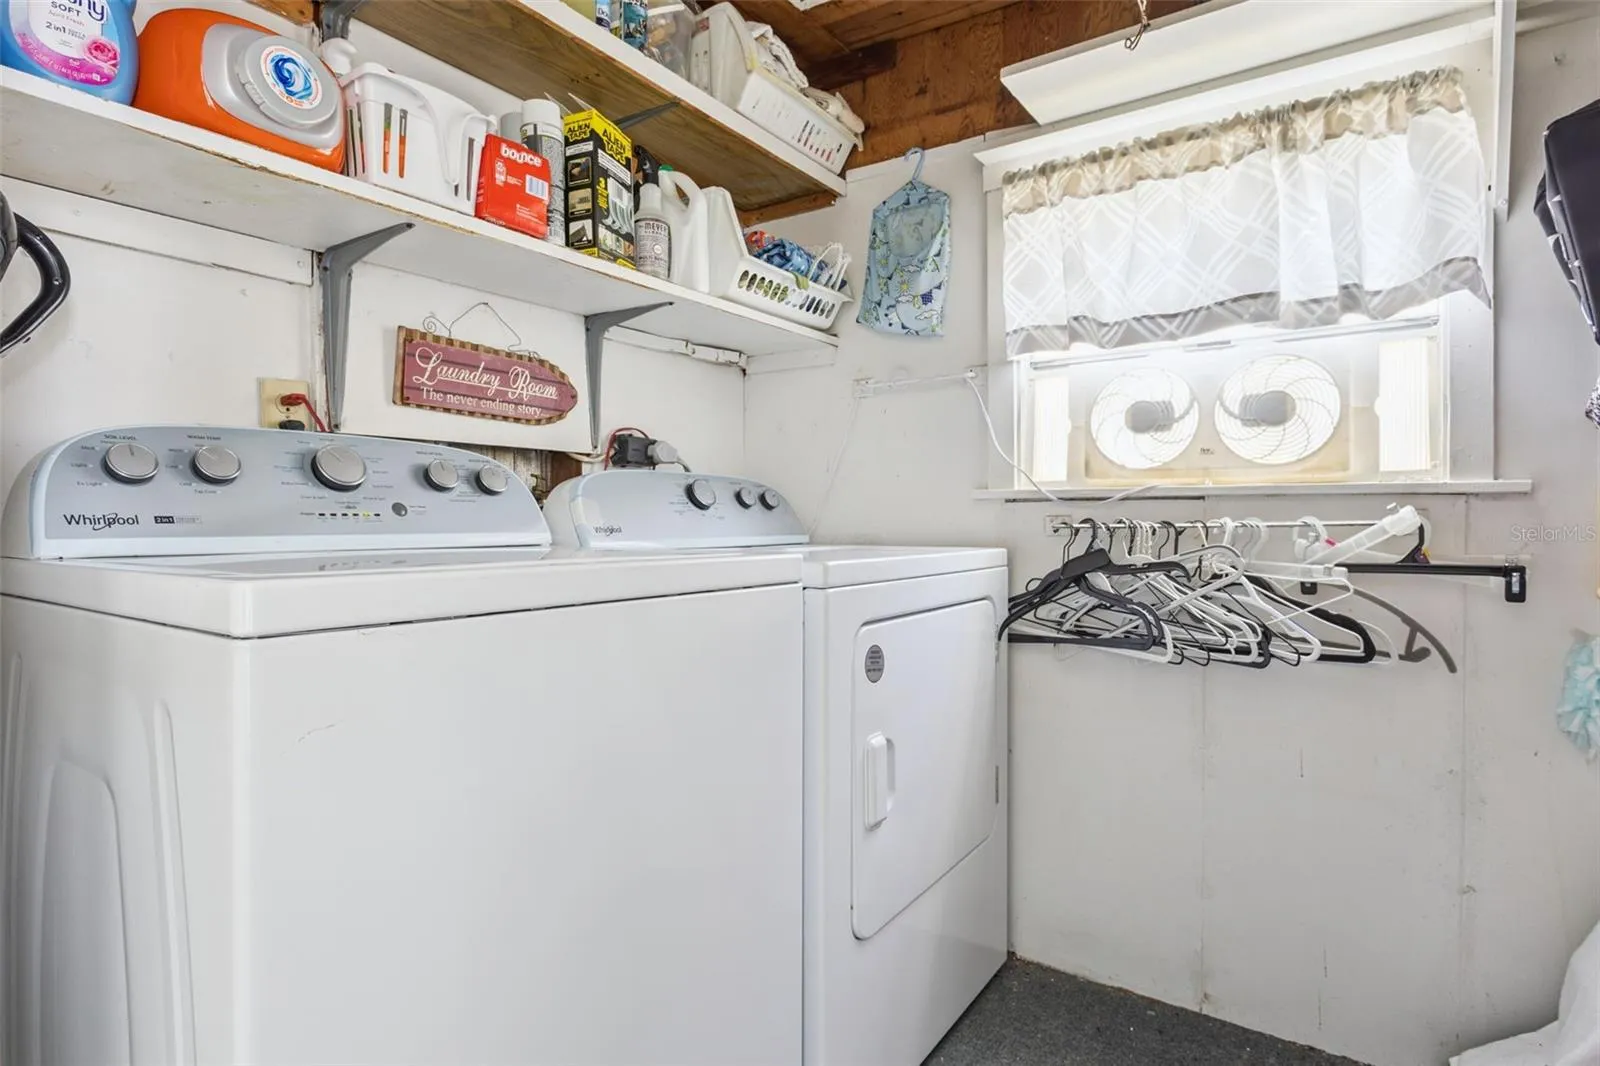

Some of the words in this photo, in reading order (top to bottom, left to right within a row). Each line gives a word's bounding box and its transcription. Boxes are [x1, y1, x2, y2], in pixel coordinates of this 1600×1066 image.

[50, 1, 82, 17] SOFT
[567, 122, 591, 134] ALIEN
[500, 142, 542, 168] bounce
[412, 345, 501, 396] Laundry
[507, 365, 559, 401] Room
[419, 385, 445, 402] The
[446, 392, 478, 408] never
[480, 397, 515, 415] ending
[63, 512, 140, 531] Whirlpool
